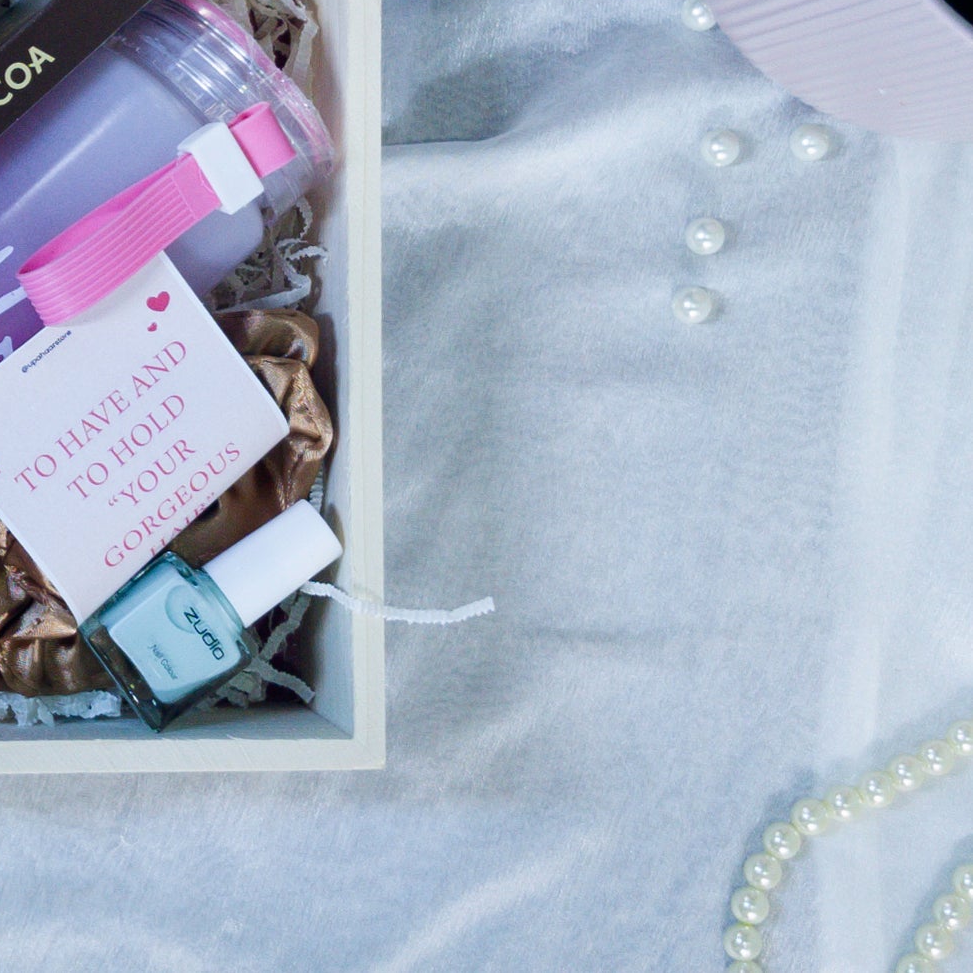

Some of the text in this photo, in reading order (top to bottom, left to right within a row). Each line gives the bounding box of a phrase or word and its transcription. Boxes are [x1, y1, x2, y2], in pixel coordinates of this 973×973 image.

[14, 339, 188, 493] TO HAVE AND
[66, 394, 186, 502] TO HOLD
[104, 442, 241, 569] GORGEOUS
[183, 606, 225, 660] zudio
